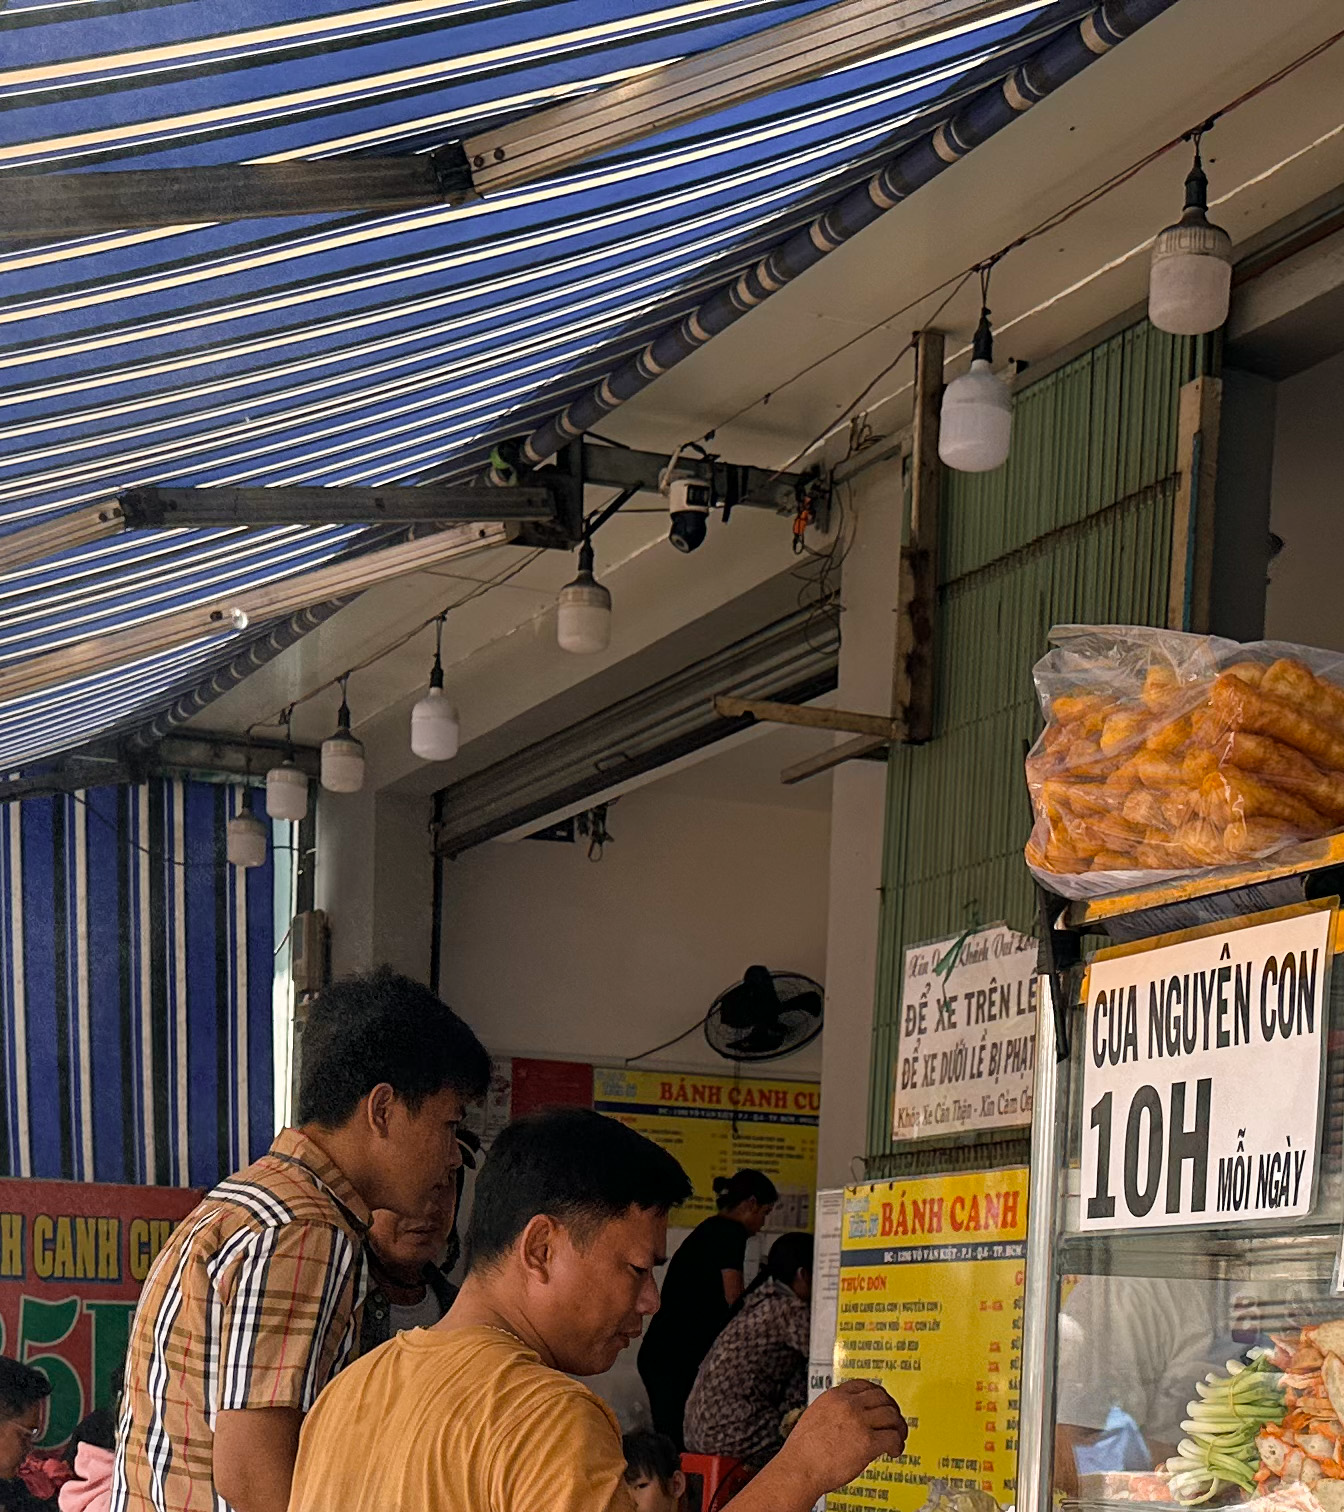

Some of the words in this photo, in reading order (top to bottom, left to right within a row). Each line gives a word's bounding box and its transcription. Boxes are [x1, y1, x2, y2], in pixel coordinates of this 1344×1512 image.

[904, 982, 931, 1038] ĐỂ
[935, 995, 958, 1033] XE
[964, 977, 1011, 1027] TRÊN
[1092, 984, 1139, 1069] CUA
[1147, 943, 1253, 1060] NGUYÊN
[1260, 947, 1319, 1042] CON
[921, 1053, 938, 1088] XE
[989, 1041, 1003, 1085] BỊ
[1004, 1034, 1036, 1080] PHẠT
[660, 1077, 723, 1104] BÁNH
[728, 1087, 789, 1109] CANH
[1087, 1077, 1213, 1219] 10H
[1217, 1147, 1253, 1212] MỖI
[1256, 1136, 1307, 1210] NGÀY
[881, 1190, 944, 1237] BÁNH
[950, 1191, 1021, 1233] CANH
[32, 1215, 123, 1284] CANH
